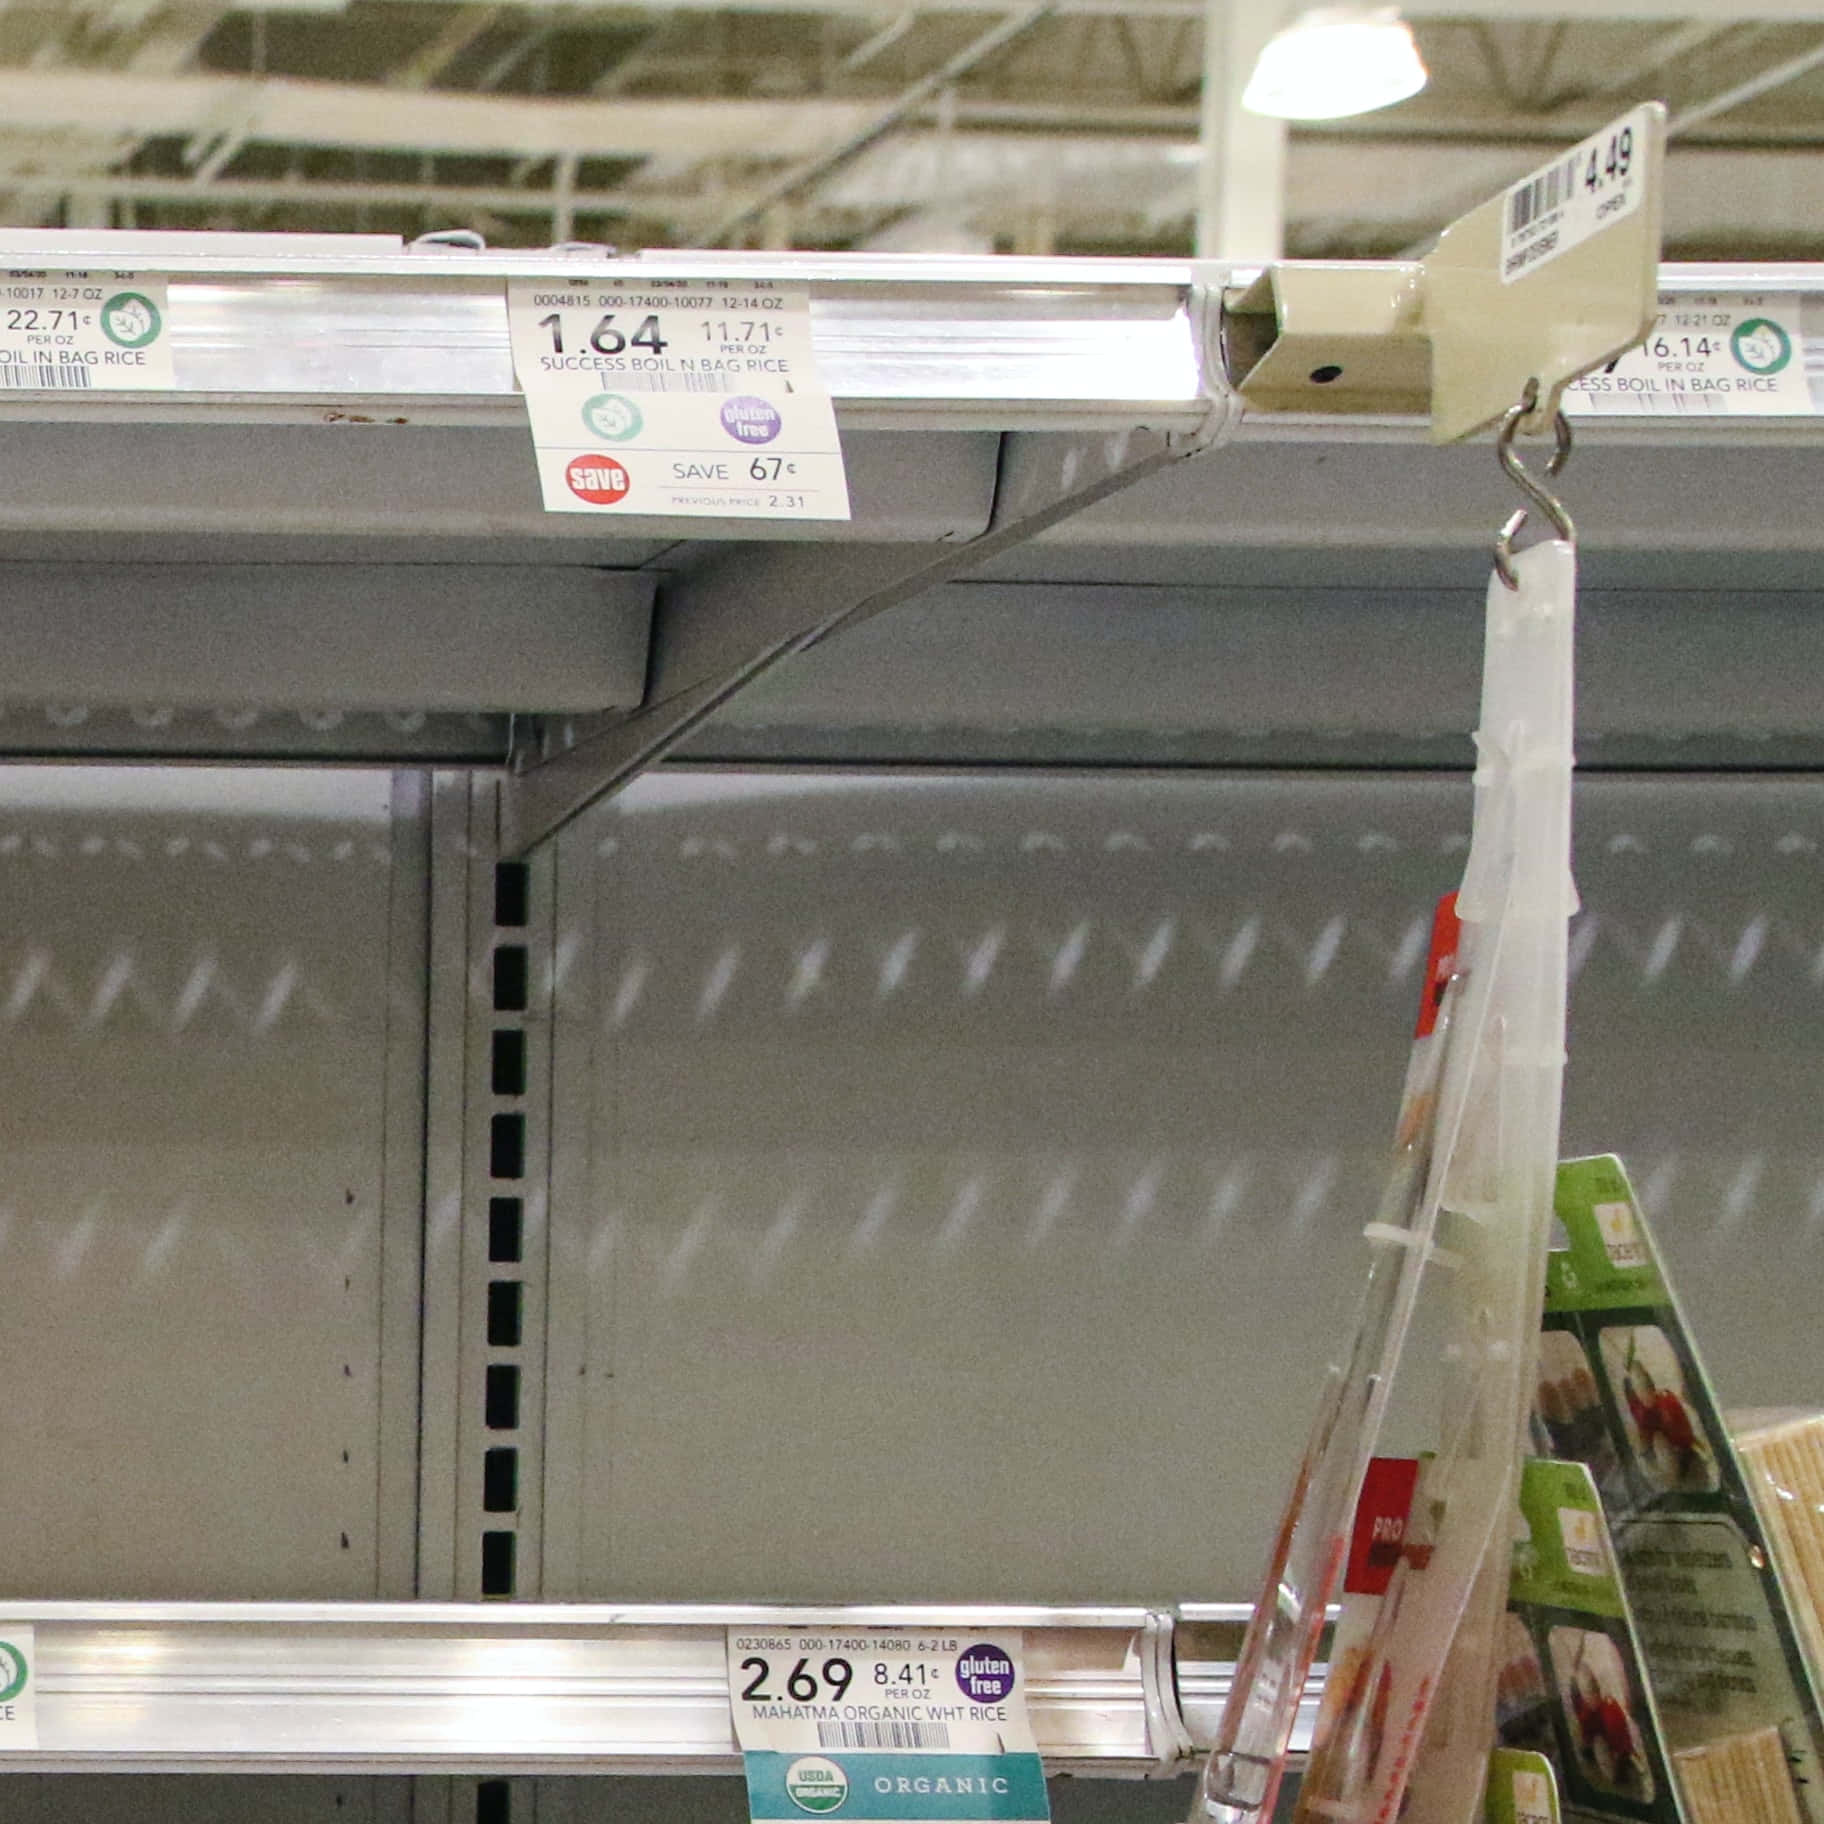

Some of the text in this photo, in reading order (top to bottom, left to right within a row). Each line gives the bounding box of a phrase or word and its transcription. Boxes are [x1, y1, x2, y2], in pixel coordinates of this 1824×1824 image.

[7, 310, 91, 330] 22.71¢
[537, 314, 668, 355] 1.64
[701, 321, 783, 342] 11.71¢
[34, 350, 52, 364] IN
[59, 351, 99, 365] BAG
[105, 352, 145, 366] RICE
[570, 467, 625, 491] save
[672, 457, 797, 481] SAVE 67¢
[1372, 1517, 1403, 1542] PRO
[874, 1664, 939, 1686] 8.41¢
[959, 1656, 1009, 1678] gluten
[740, 1658, 853, 1702] 2.69
[969, 1677, 1002, 1695] free
[752, 1706, 1007, 1721] MAHATMA ORGANIC WHT RICE
[874, 1777, 1009, 1794] ORGANIC
